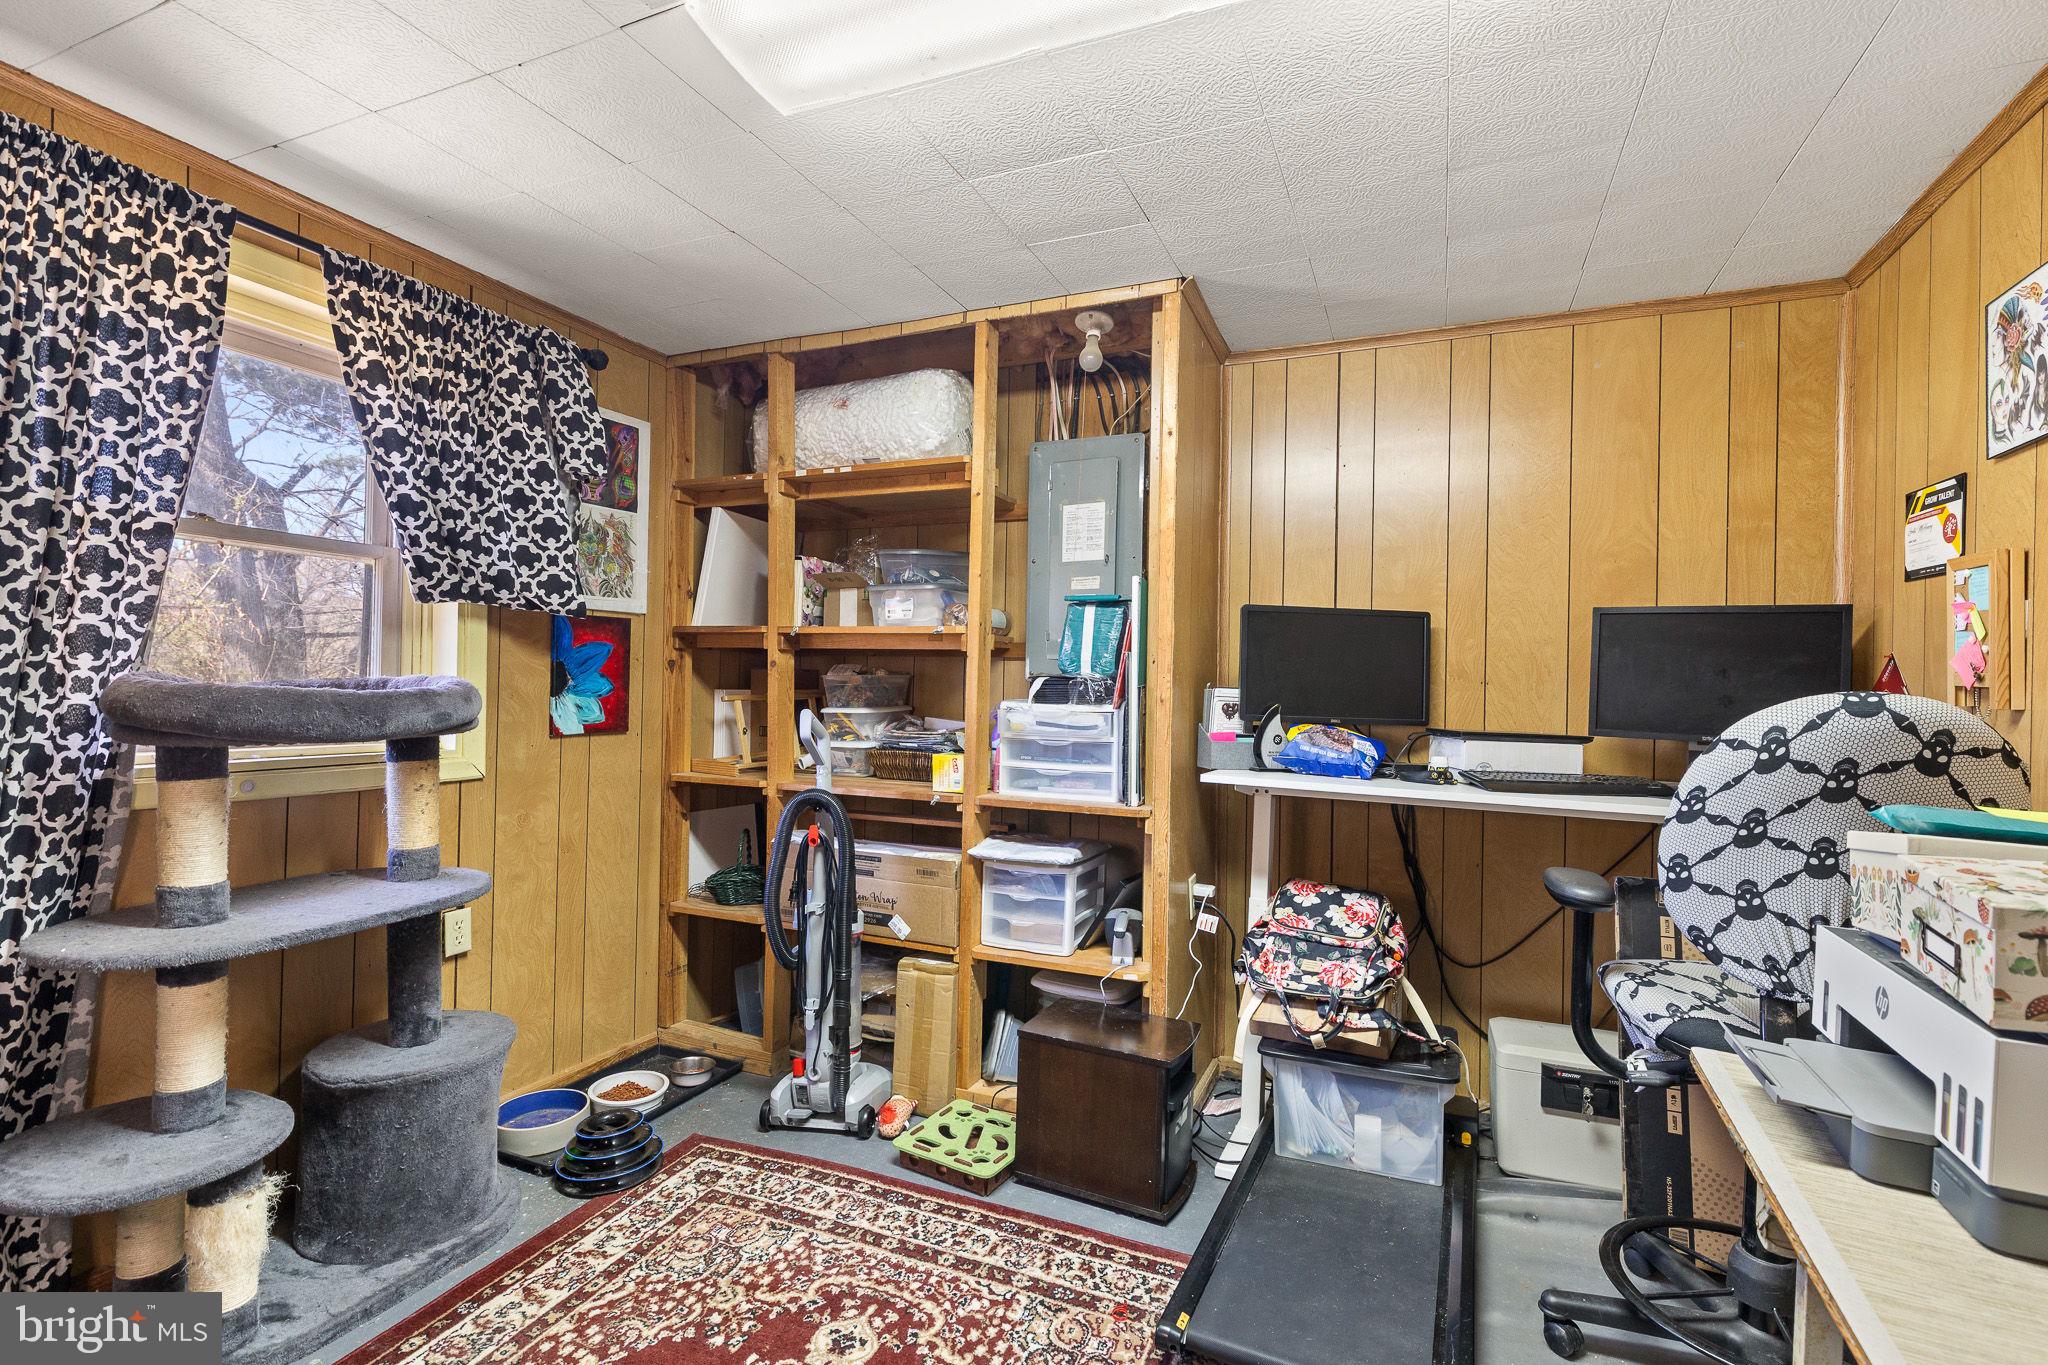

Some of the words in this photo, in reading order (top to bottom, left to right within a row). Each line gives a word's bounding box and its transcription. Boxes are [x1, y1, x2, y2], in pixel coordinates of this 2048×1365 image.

[1938, 489, 1956, 501] TALENT
[869, 890, 898, 911] Wrap
[1876, 985, 1888, 1020] hp
